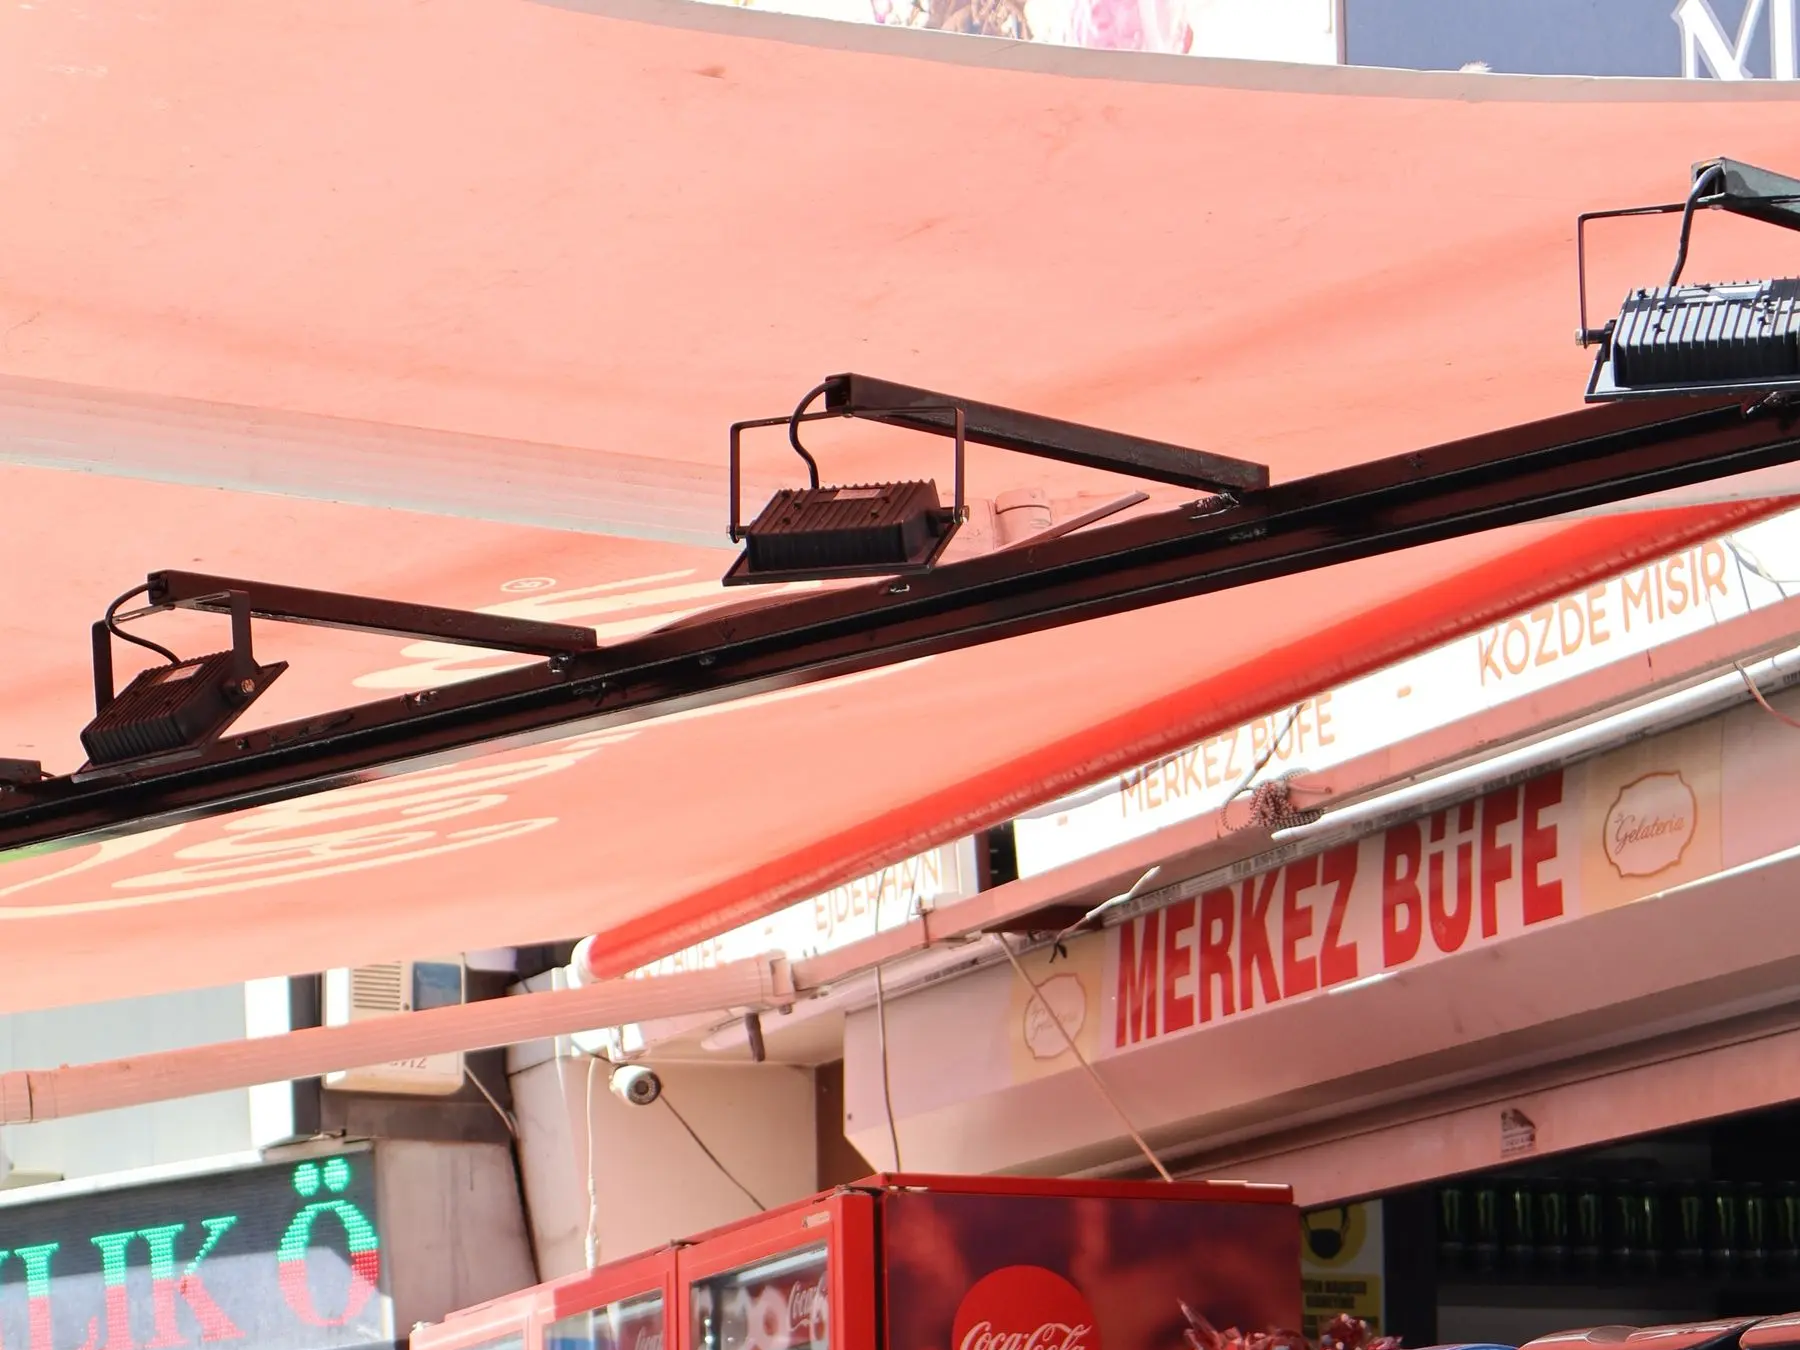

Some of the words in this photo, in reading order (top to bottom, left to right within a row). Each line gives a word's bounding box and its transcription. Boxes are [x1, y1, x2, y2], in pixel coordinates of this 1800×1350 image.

[1119, 730, 1242, 818] MERKEZ
[1115, 838, 1360, 1049] MERKEZ
[1383, 768, 1565, 969] BÜFE
[277, 1157, 382, 1328] Ö
